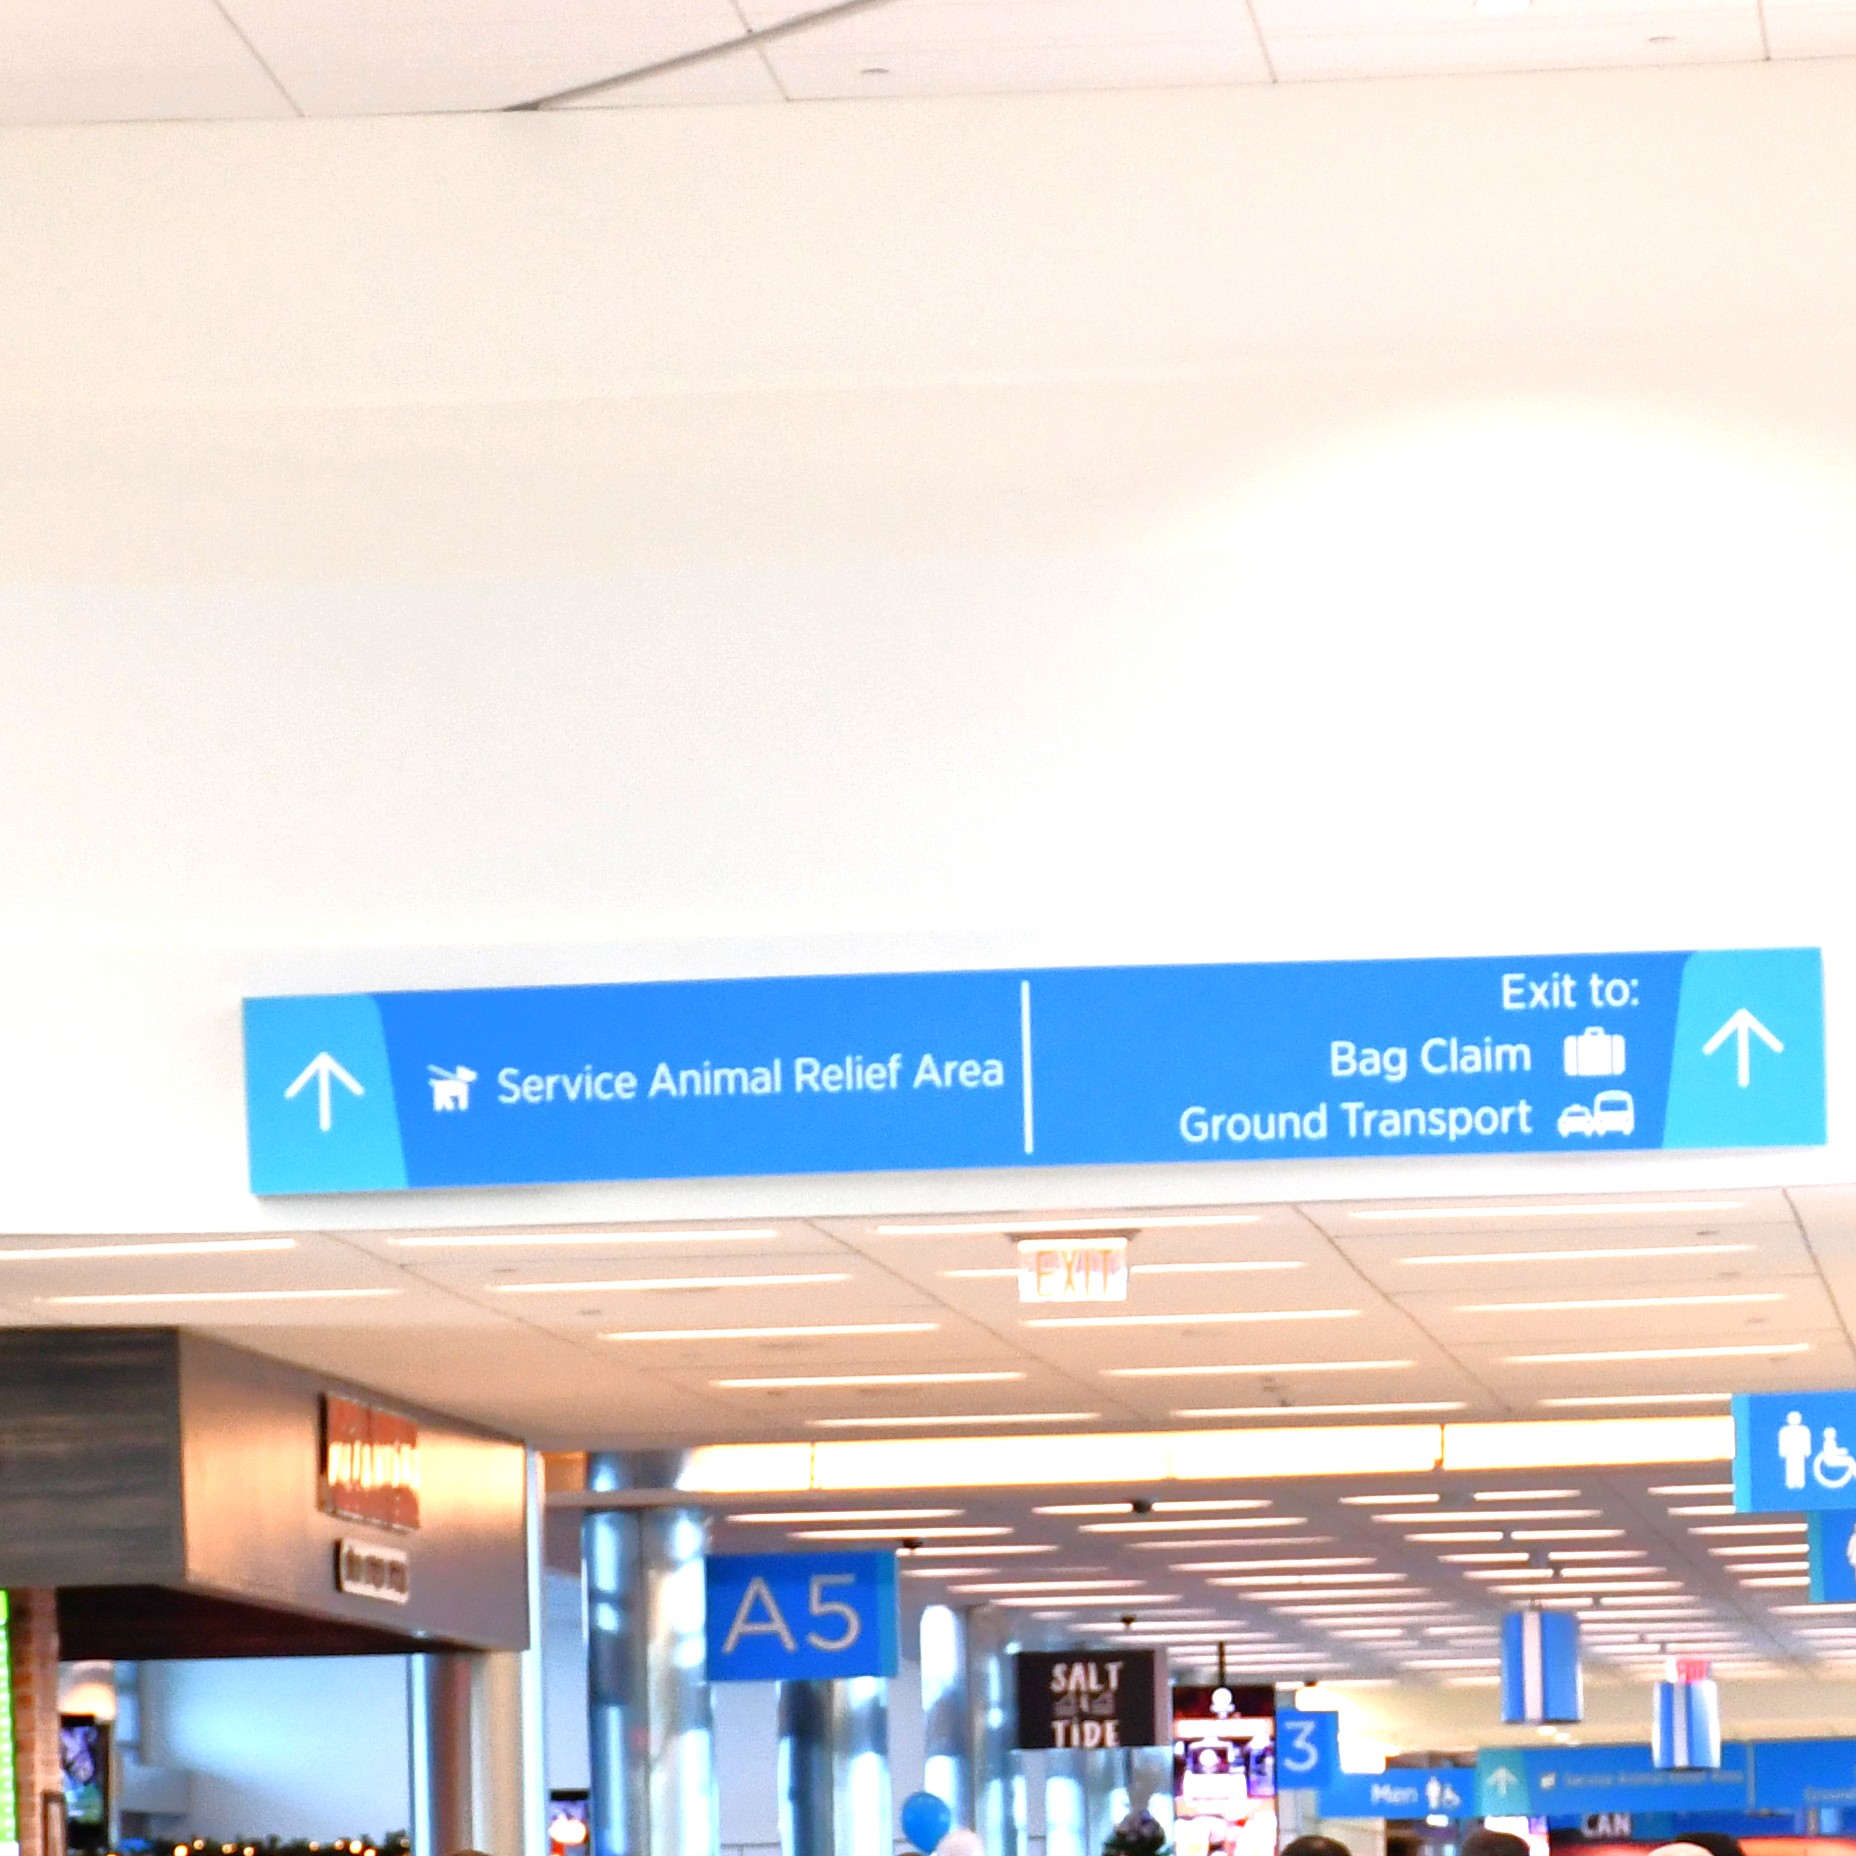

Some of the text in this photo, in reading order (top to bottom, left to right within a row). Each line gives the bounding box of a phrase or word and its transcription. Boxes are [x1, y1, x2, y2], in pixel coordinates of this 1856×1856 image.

[1501, 972, 1640, 1011] Exit to:
[497, 1053, 1005, 1104] Service Animal Relief Area
[1330, 1036, 1532, 1082] Bag Claim
[1179, 1099, 1533, 1143] Ground Transport
[1035, 1249, 1114, 1297] EXIT
[721, 1573, 862, 1654] A5
[1049, 1661, 1124, 1694] SALT
[1050, 1718, 1121, 1748] TIDE
[1370, 1783, 1419, 1805] Men
